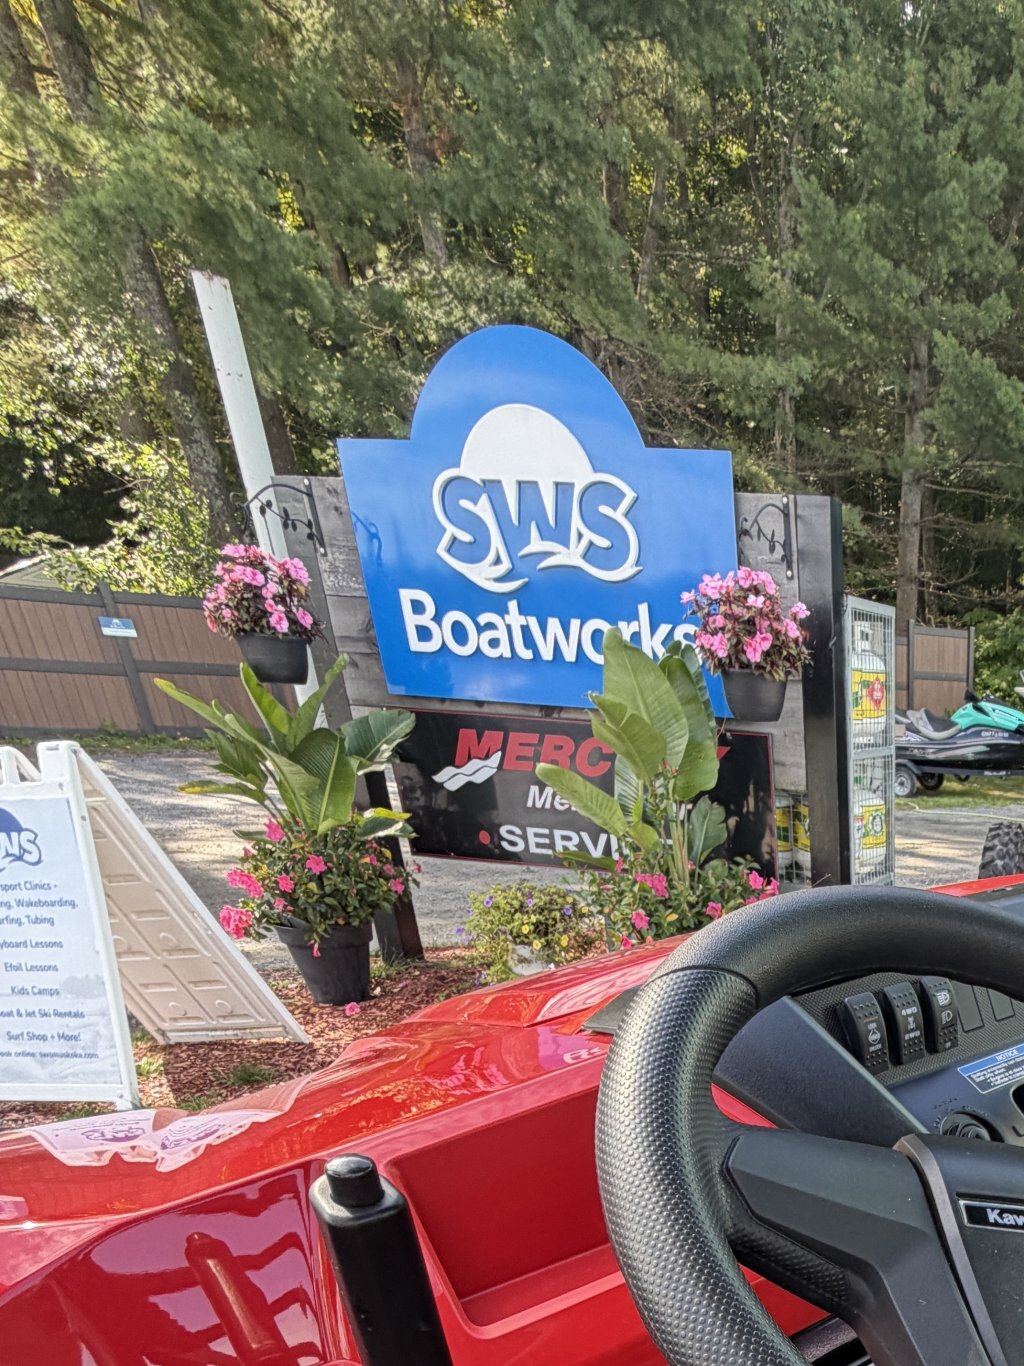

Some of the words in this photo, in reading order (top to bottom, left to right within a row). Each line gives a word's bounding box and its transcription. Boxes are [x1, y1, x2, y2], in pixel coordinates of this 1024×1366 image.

[433, 467, 643, 592] SWS
[399, 588, 704, 667] Boatworks
[454, 728, 730, 778] MERC
[500, 825, 673, 861] SERVI
[0, 882, 23, 893] sport
[23, 880, 52, 891] Clinics
[14, 897, 79, 909] Wakeboarding,
[25, 914, 55, 927] Tubing
[29, 939, 63, 949] Lessons
[4, 962, 24, 972] Efoil
[25, 962, 59, 972] Lessons
[11, 985, 29, 996] Kids
[31, 985, 60, 997] Camps
[25, 1008, 37, 1018] Jet
[38, 1008, 52, 1018] Ski
[53, 1009, 85, 1019] Rentals
[6, 1031, 24, 1041] Surf
[26, 1031, 48, 1043] Shop
[995, 1049, 1019, 1062] NOTICE
